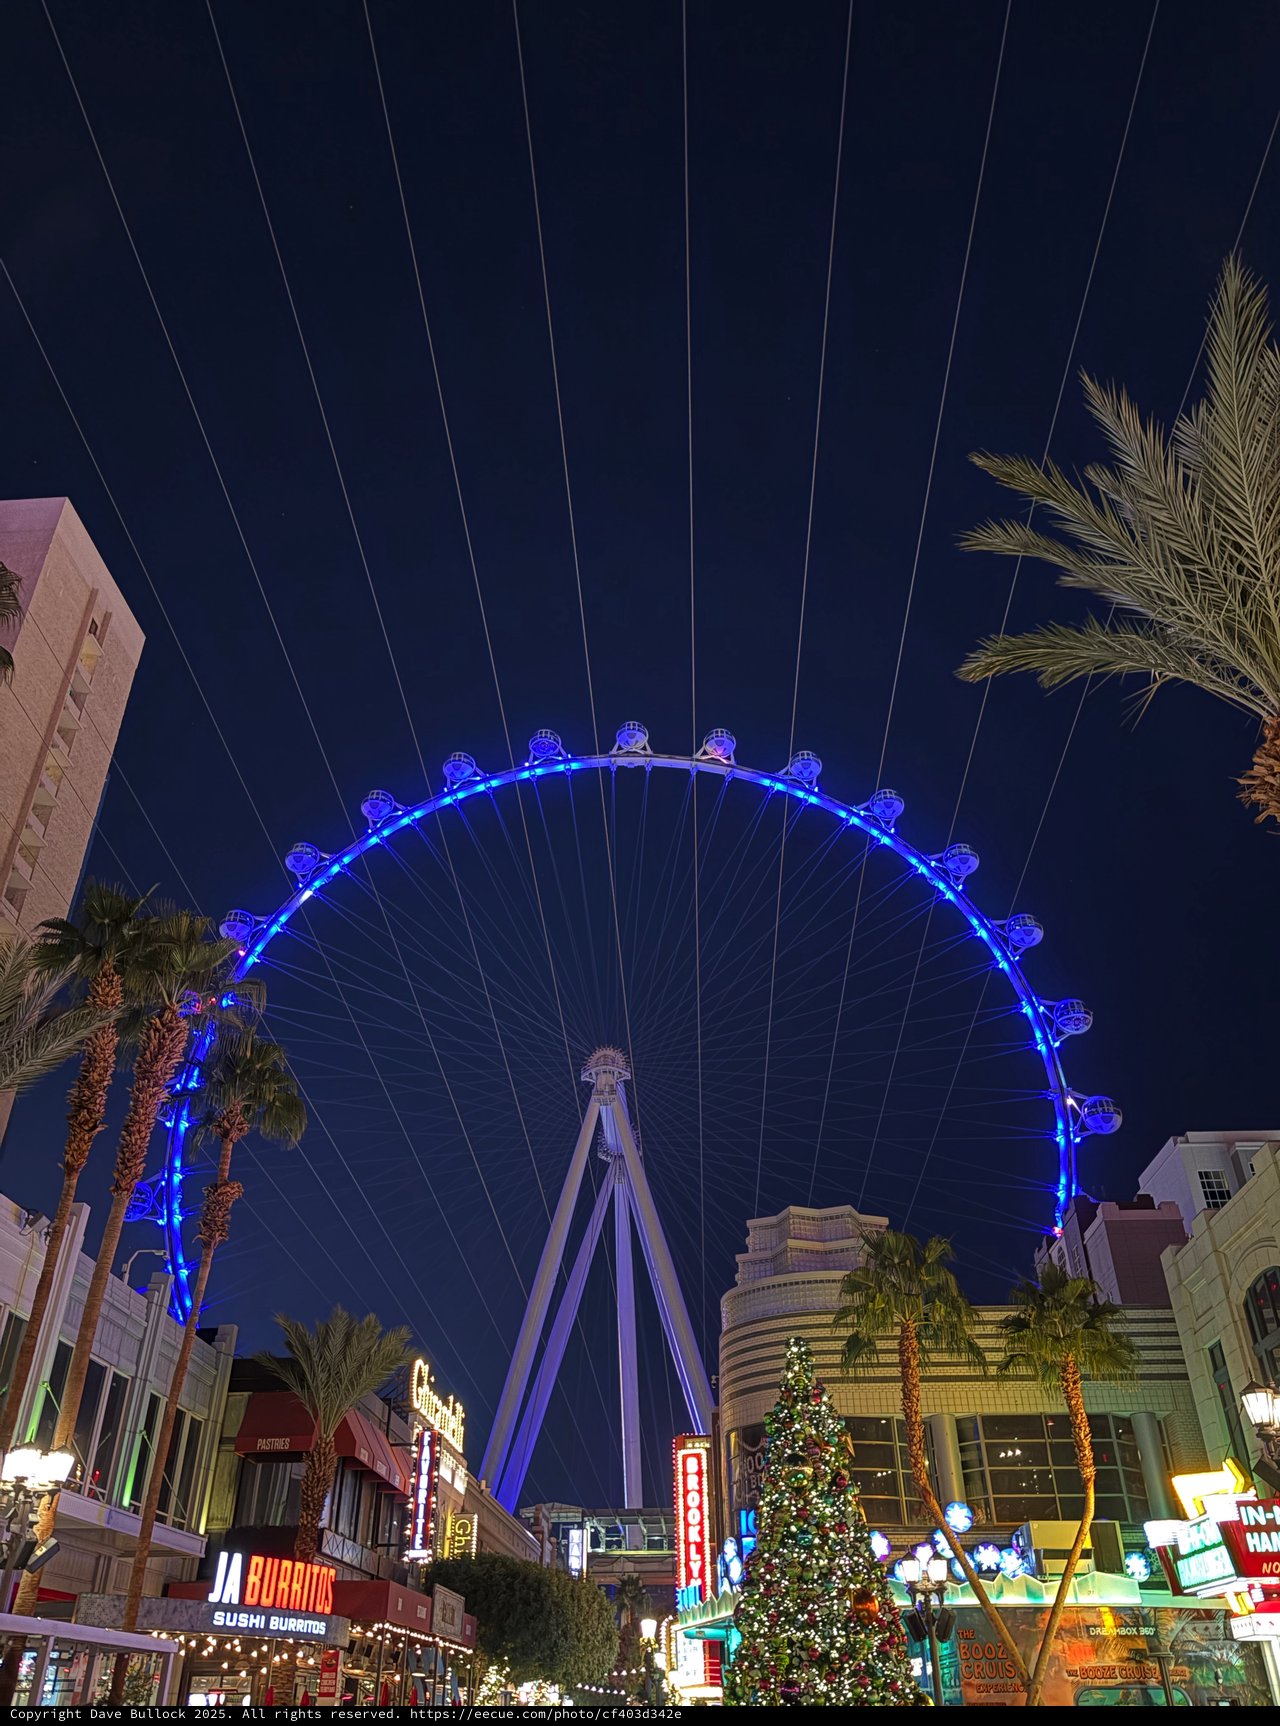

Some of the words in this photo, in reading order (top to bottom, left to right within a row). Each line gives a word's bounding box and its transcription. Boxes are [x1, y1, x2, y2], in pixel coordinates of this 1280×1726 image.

[257, 1438, 290, 1450] PASTRIES
[208, 1552, 243, 1605] JA
[244, 1555, 336, 1614] BURRITOS
[213, 1611, 265, 1629] SUSHI
[269, 1616, 326, 1636] BURRITOS
[958, 1629, 976, 1639] THE
[960, 1643, 1008, 1660] BOOZ
[961, 1661, 1017, 1679] CRUIS
[1080, 1666, 1117, 1679] BOOZE
[1119, 1664, 1158, 1679] CRUISE
